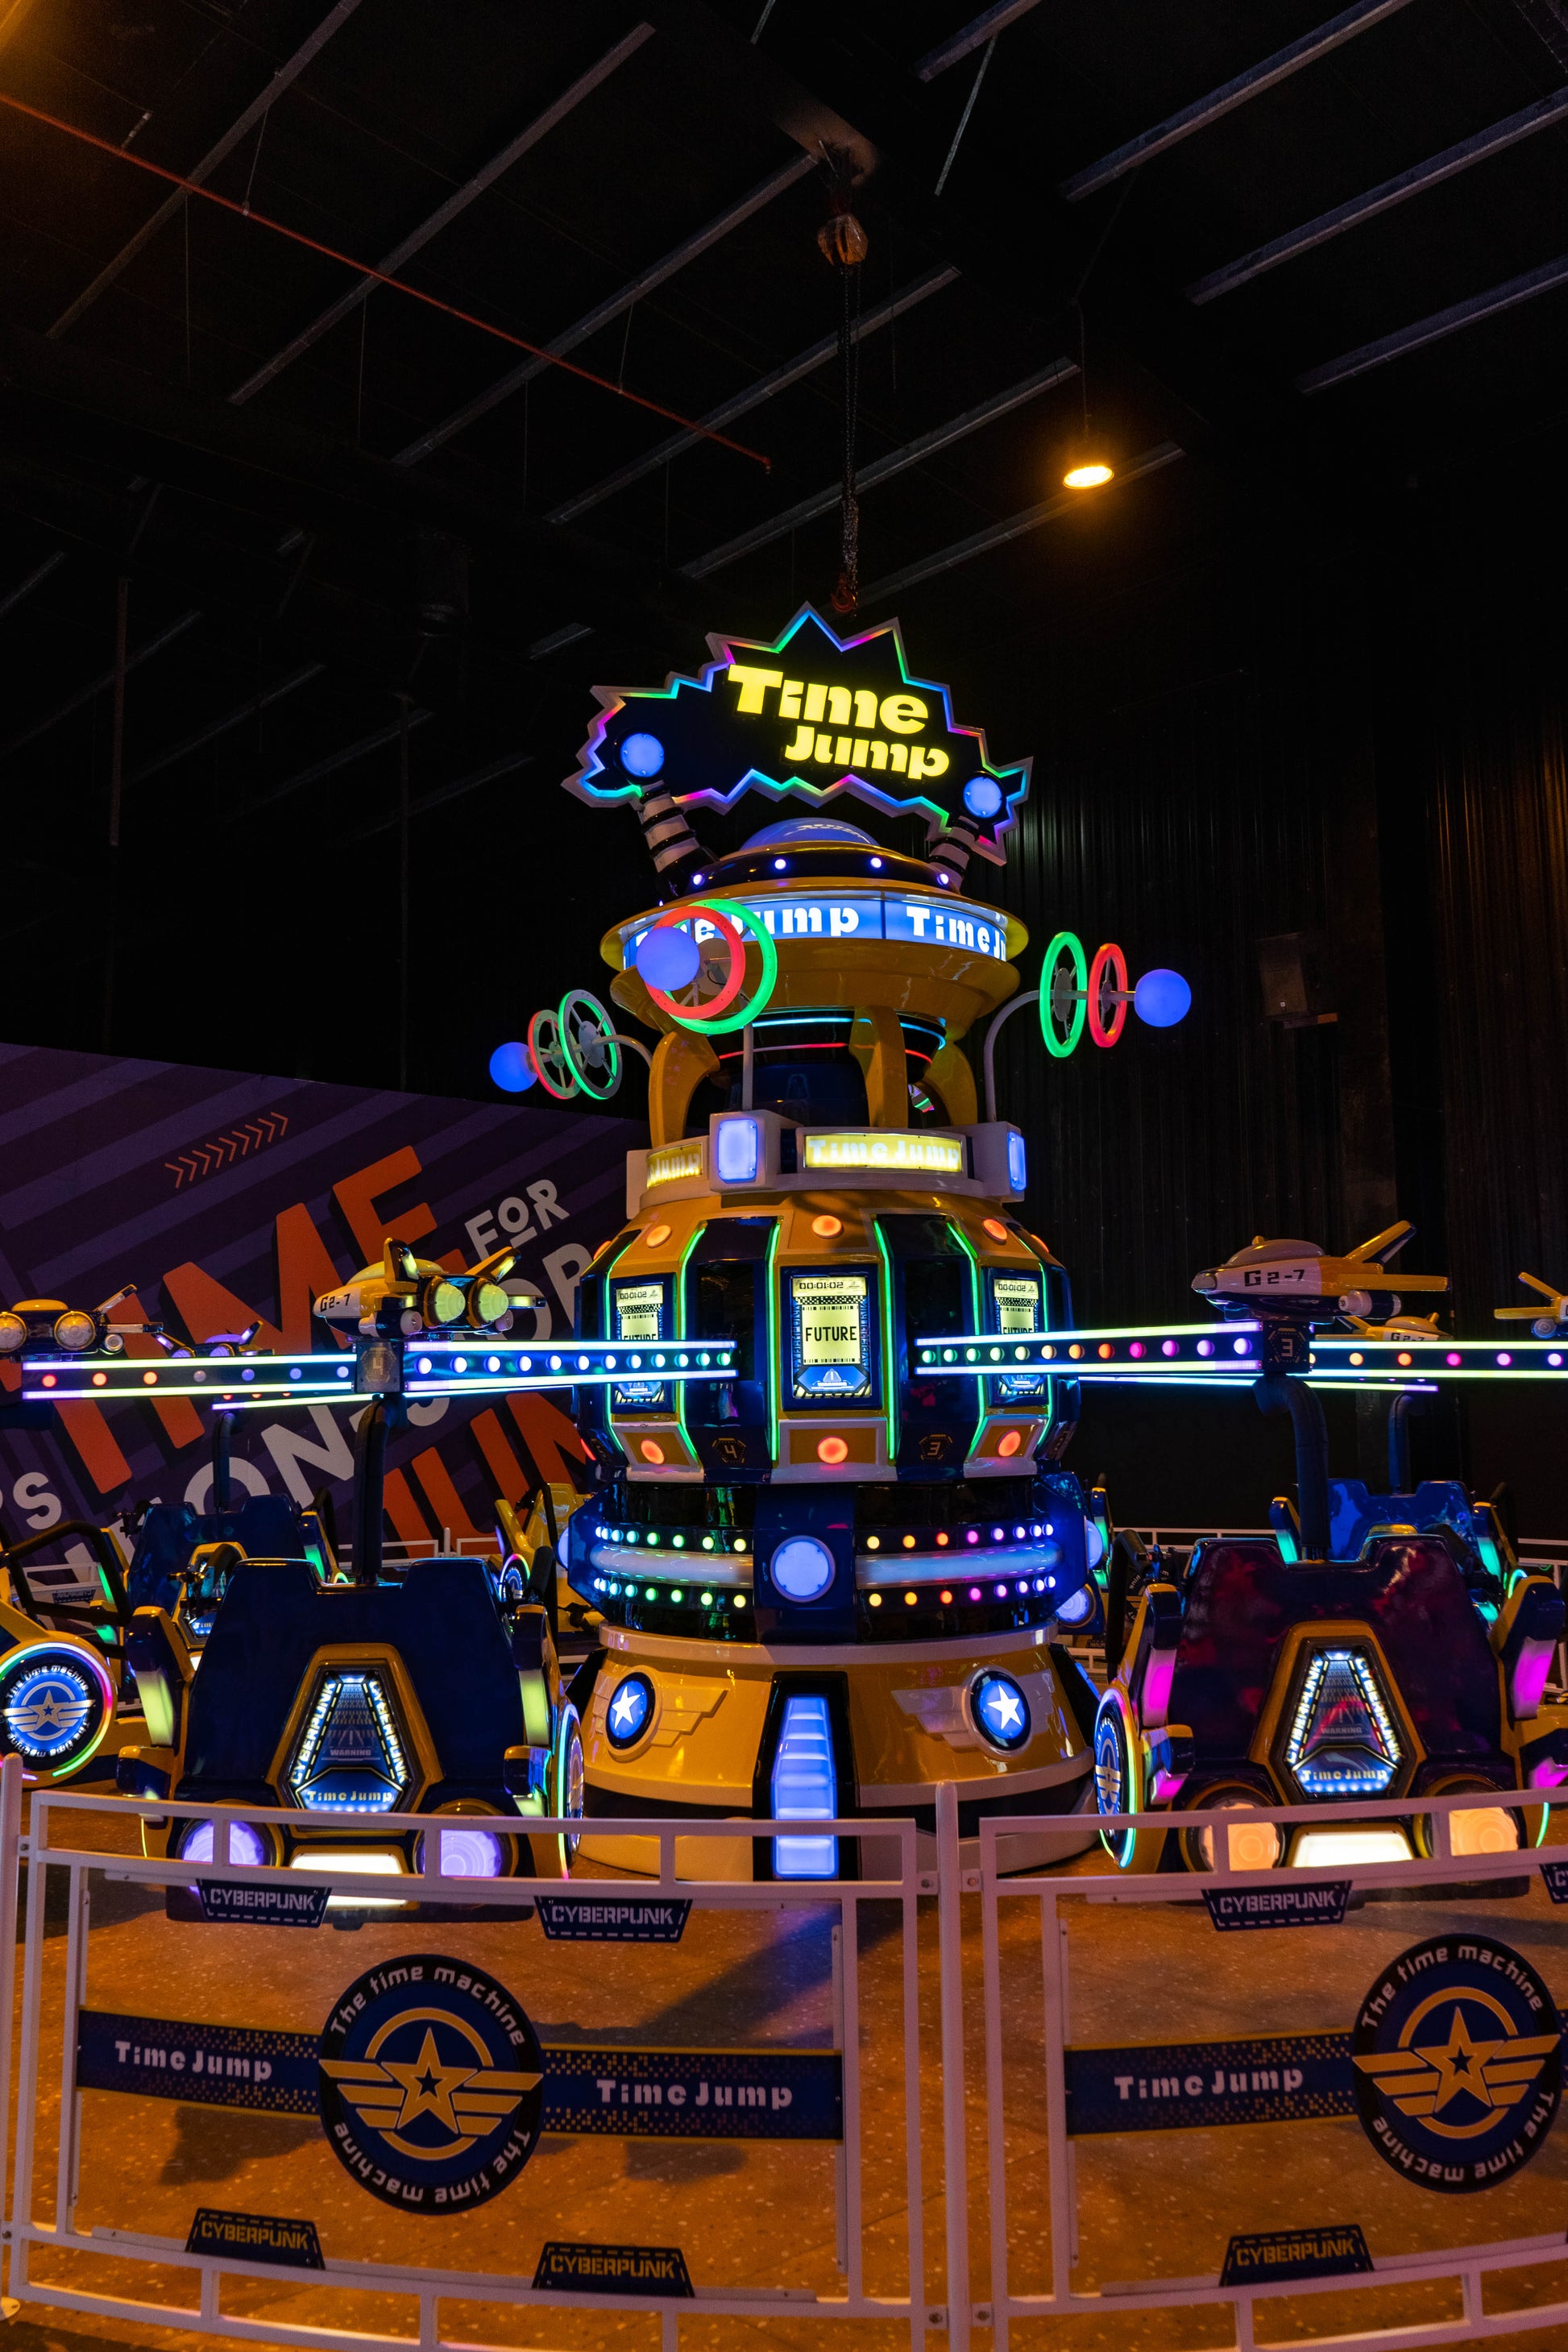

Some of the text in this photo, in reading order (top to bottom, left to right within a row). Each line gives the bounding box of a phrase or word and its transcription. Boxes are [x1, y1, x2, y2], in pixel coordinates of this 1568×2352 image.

[728, 664, 929, 735] Time
[784, 725, 950, 781] Jump
[906, 906, 990, 953] Time
[808, 1139, 960, 1168] Time Jump
[464, 1179, 570, 1261] FOR
[799, 1281, 844, 1290] 00:01:02
[1244, 1269, 1305, 1287] G2-7
[320, 1293, 351, 1313] G2-7
[806, 1326, 857, 1342] FUTURE
[1280, 1338, 1293, 1358] 3
[372, 1356, 384, 1375] 4
[724, 1445, 738, 1458] 4
[927, 1441, 940, 1456] 3
[290, 1682, 337, 1786] CYBERPUNK
[369, 1681, 409, 1784] CYBERPUNK
[1301, 1769, 1388, 1782] Time Jump
[308, 1790, 393, 1803] Time Jump
[209, 1887, 317, 1912] CYBERPUNK
[1219, 1890, 1338, 1915] CYBERPUNK
[551, 1904, 675, 1927] CYBERPUNK
[1362, 1943, 1545, 2029] The time machine
[330, 1964, 525, 2048] The time machine
[114, 2039, 273, 2083] Time Jump
[596, 2078, 794, 2111] Time Jump
[1114, 2068, 1305, 2101] Time Jump
[1372, 2092, 1556, 2184] The time machine
[331, 2122, 532, 2205] The time machine
[201, 2219, 309, 2251] CYBERPUNK
[1236, 2238, 1355, 2267] CYBERPUNK
[550, 2256, 676, 2280] CYBERPUNK
